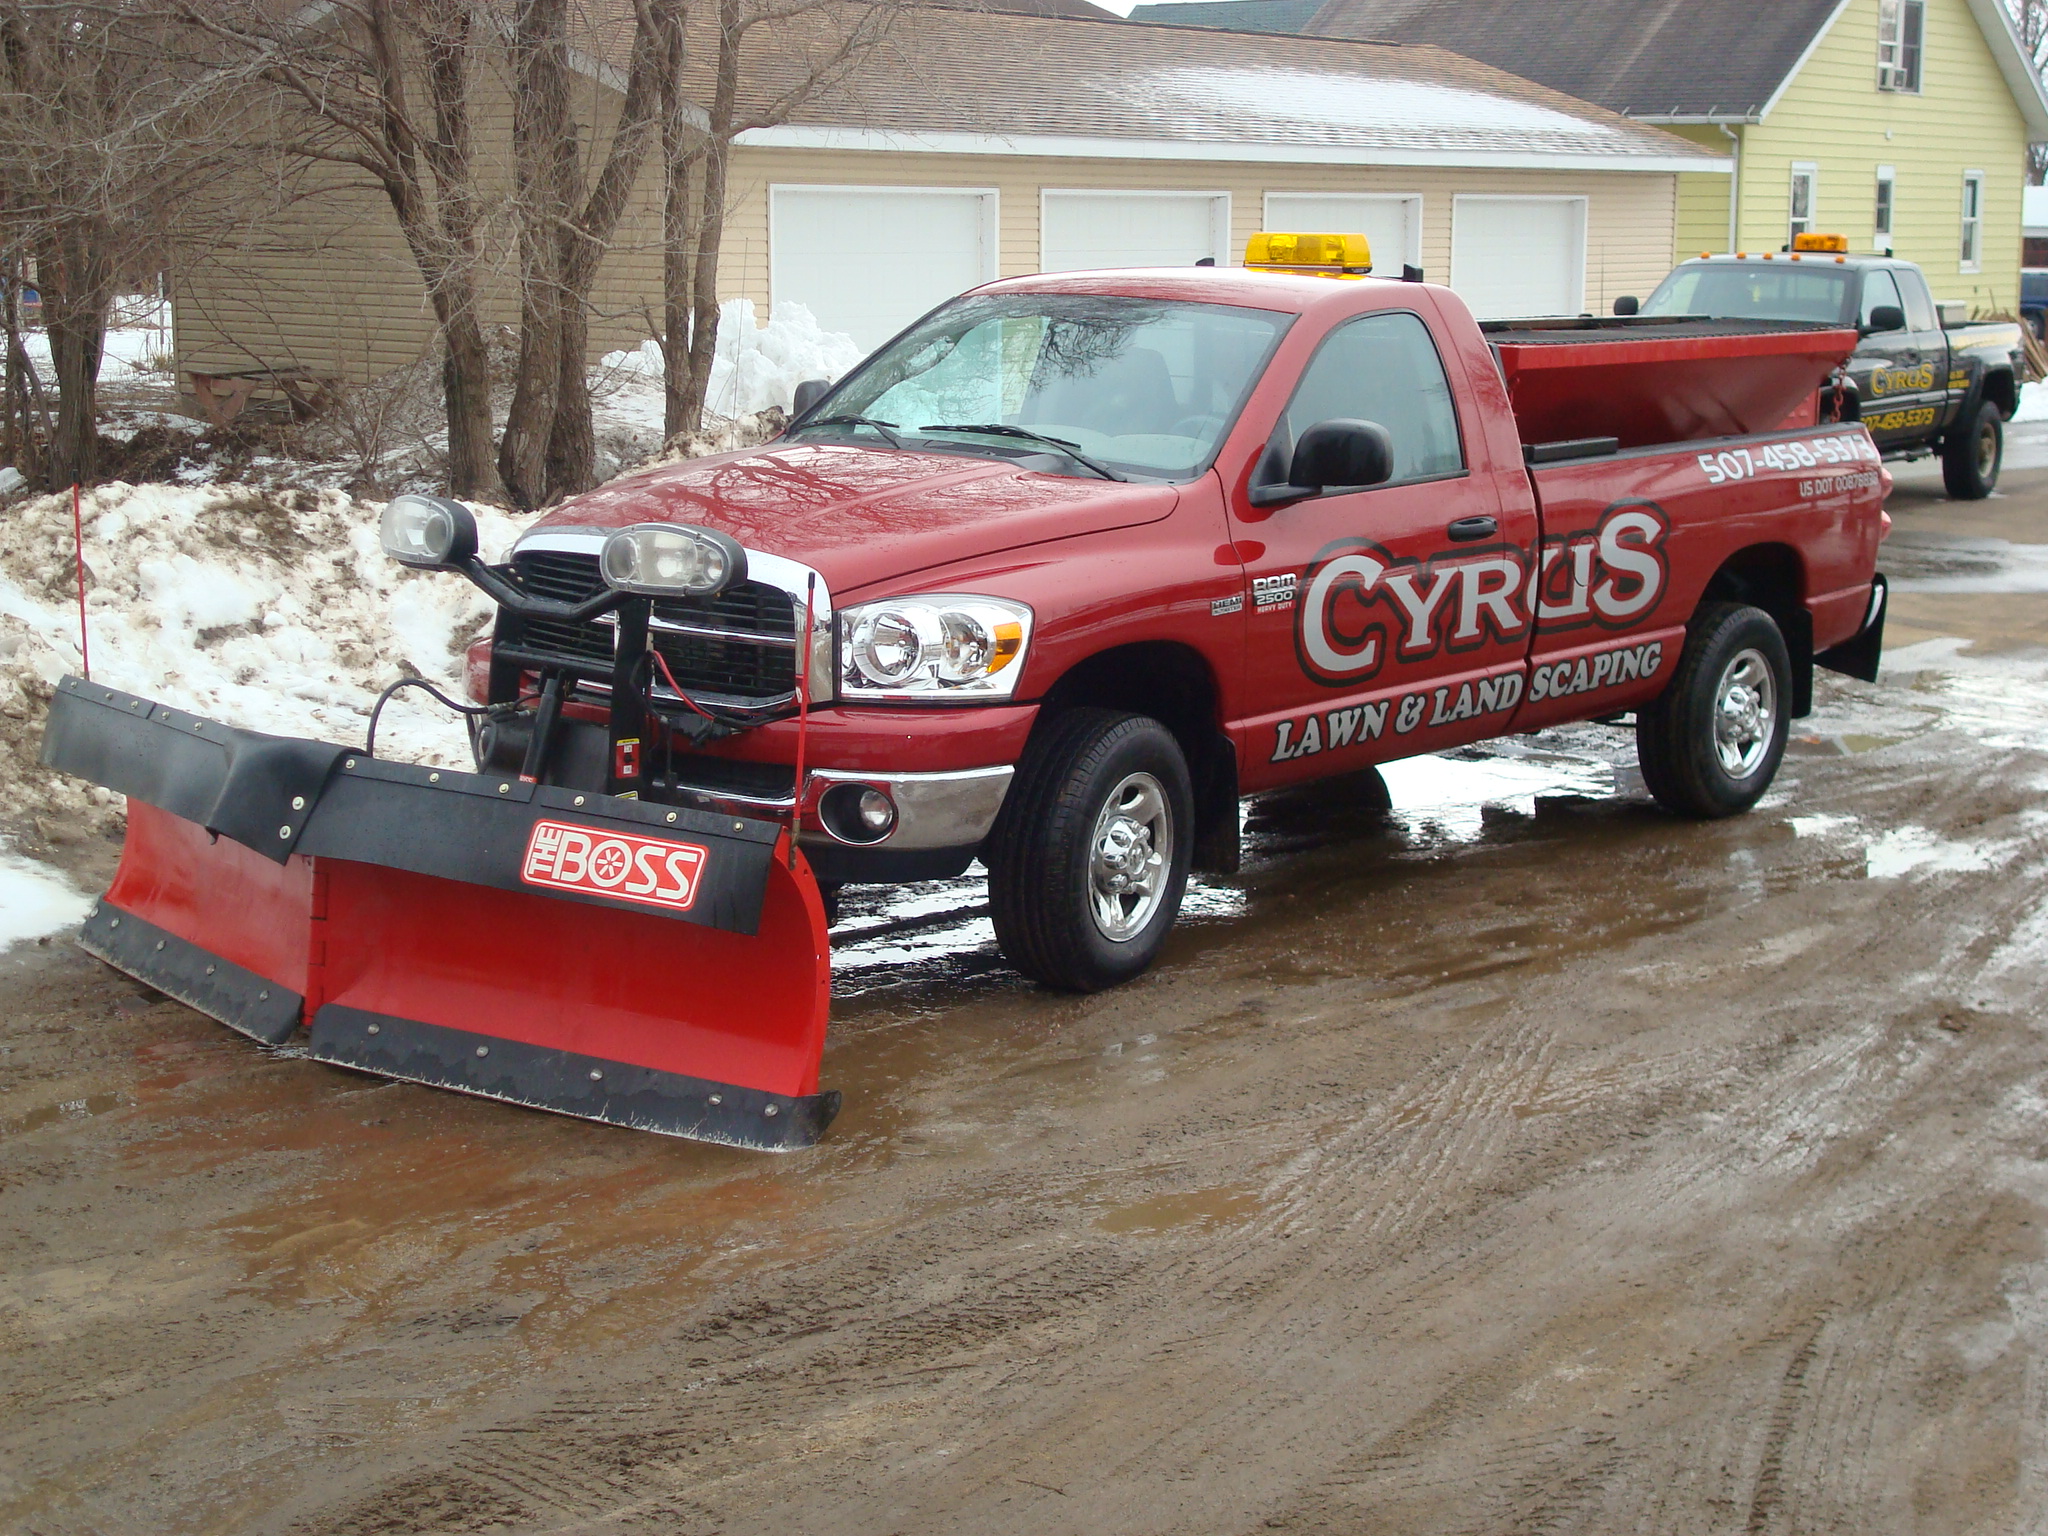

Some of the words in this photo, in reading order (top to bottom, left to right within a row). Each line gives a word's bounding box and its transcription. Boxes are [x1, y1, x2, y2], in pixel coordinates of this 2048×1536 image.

[1871, 362, 1934, 395] CYRUS
[1860, 407, 1935, 431] 07-458-5373
[1697, 433, 1877, 484] 507-458-5373
[1799, 480, 1813, 497] US
[1815, 477, 1833, 495] DOT
[1252, 573, 1297, 591] RAM
[1301, 510, 1663, 674] CYRUS
[1257, 590, 1293, 605] 2500
[1277, 601, 1292, 610] DUTY
[1270, 699, 1390, 763] LAWN
[1394, 693, 1427, 735] &
[528, 826, 563, 876] THE
[551, 831, 698, 900] BOSS
